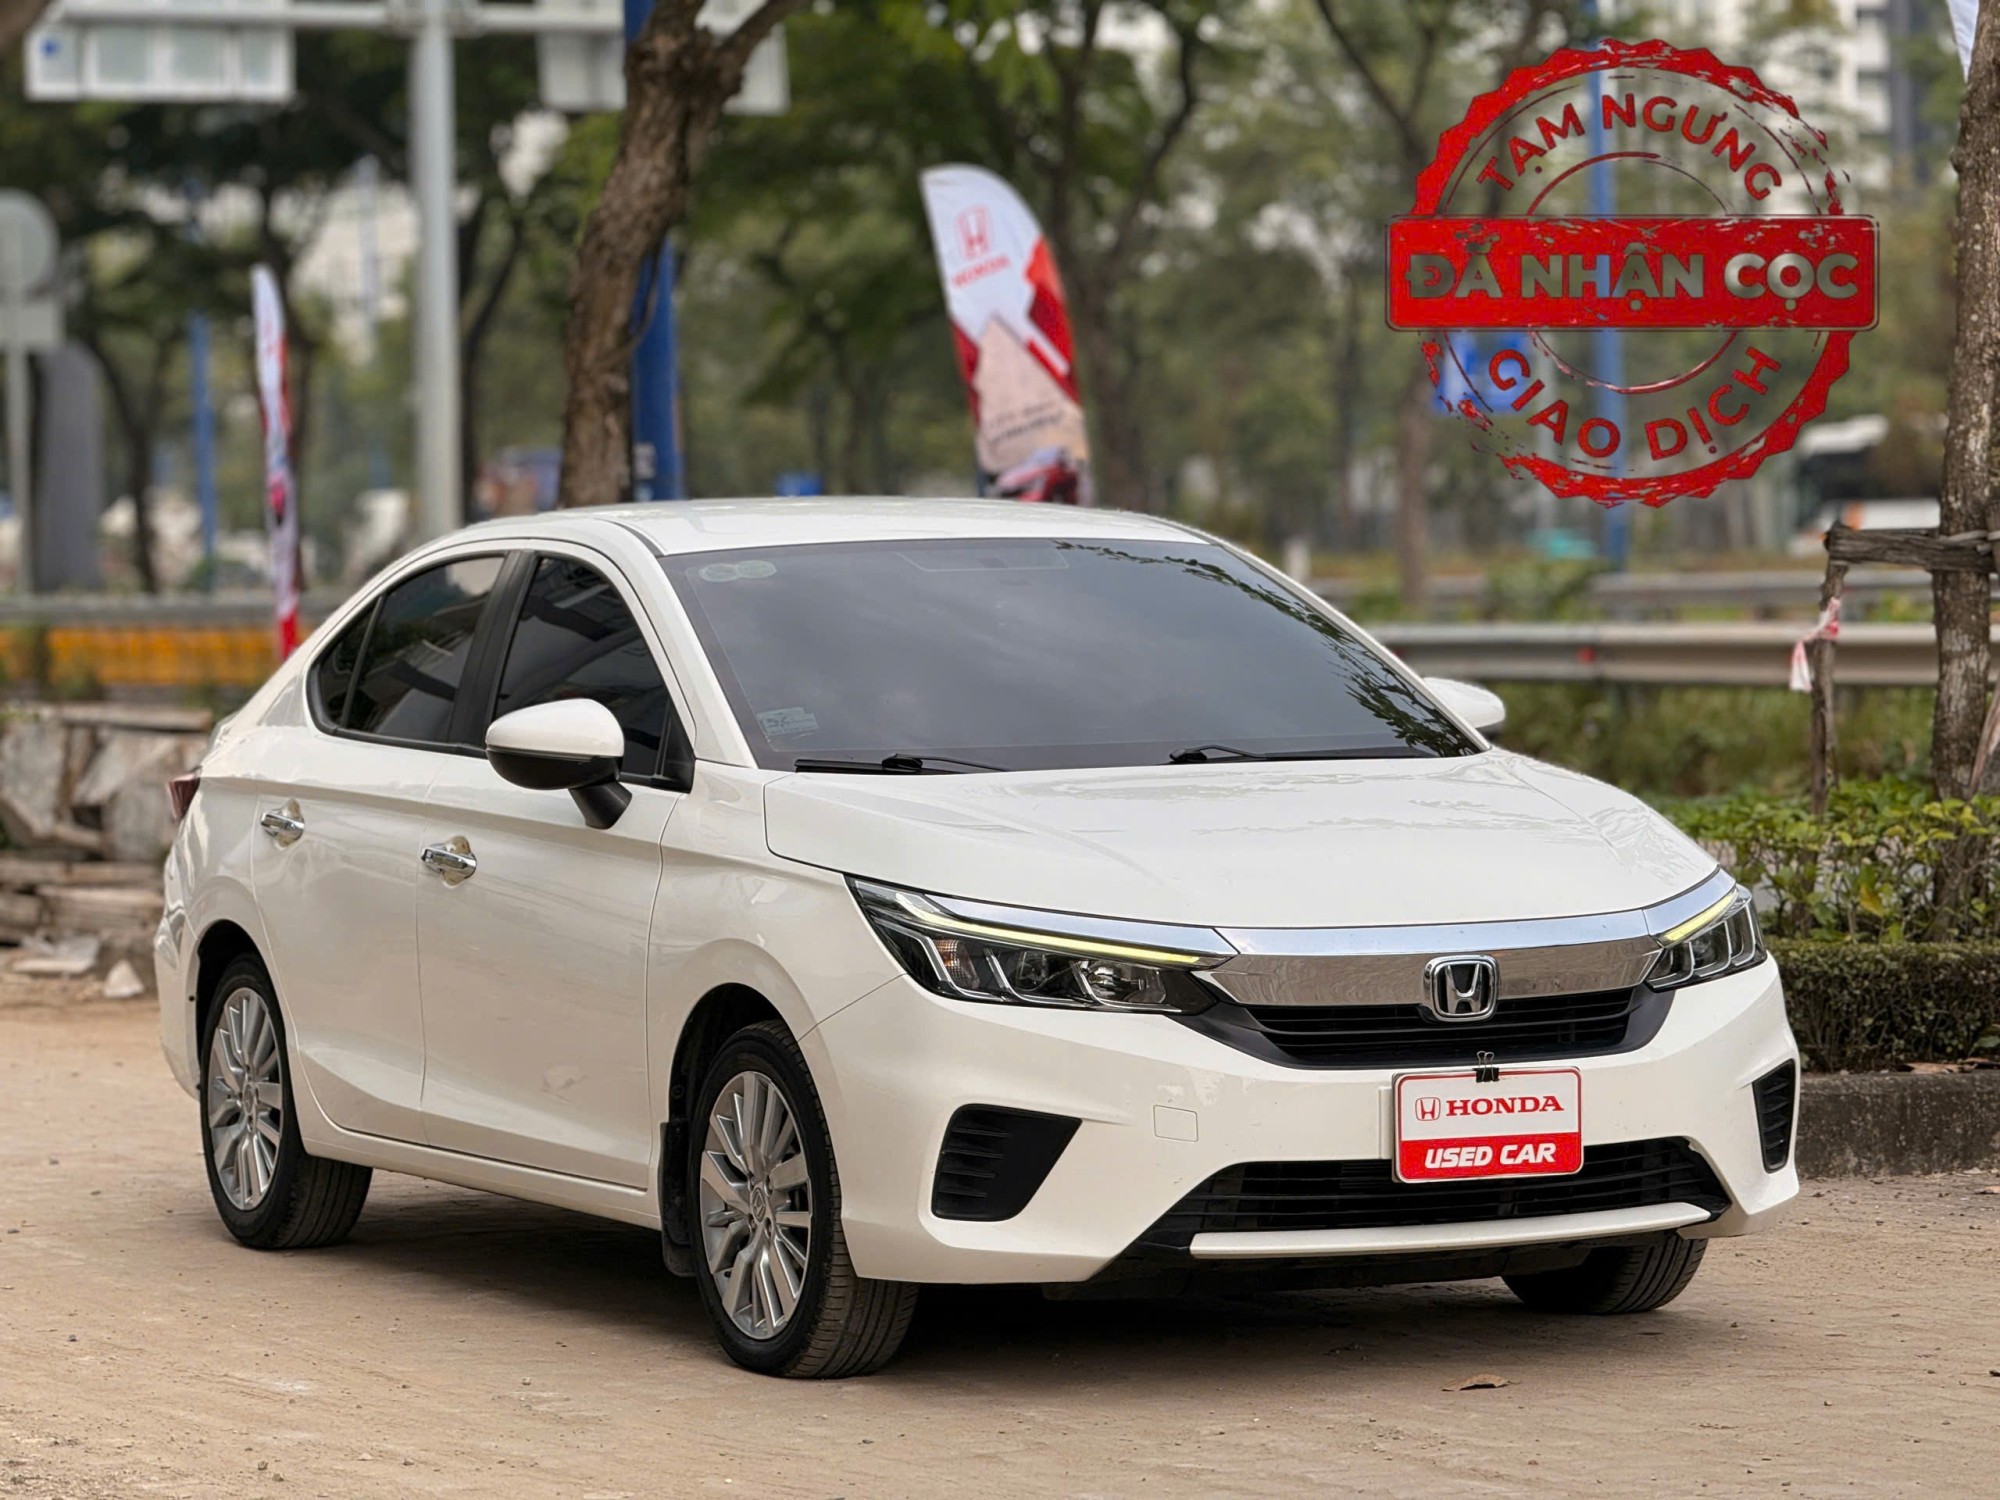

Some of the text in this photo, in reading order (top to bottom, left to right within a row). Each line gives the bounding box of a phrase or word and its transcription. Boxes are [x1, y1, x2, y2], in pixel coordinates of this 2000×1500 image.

[1446, 1095, 1564, 1116] HONDA
[1424, 1143, 1556, 1169] USED CAR
